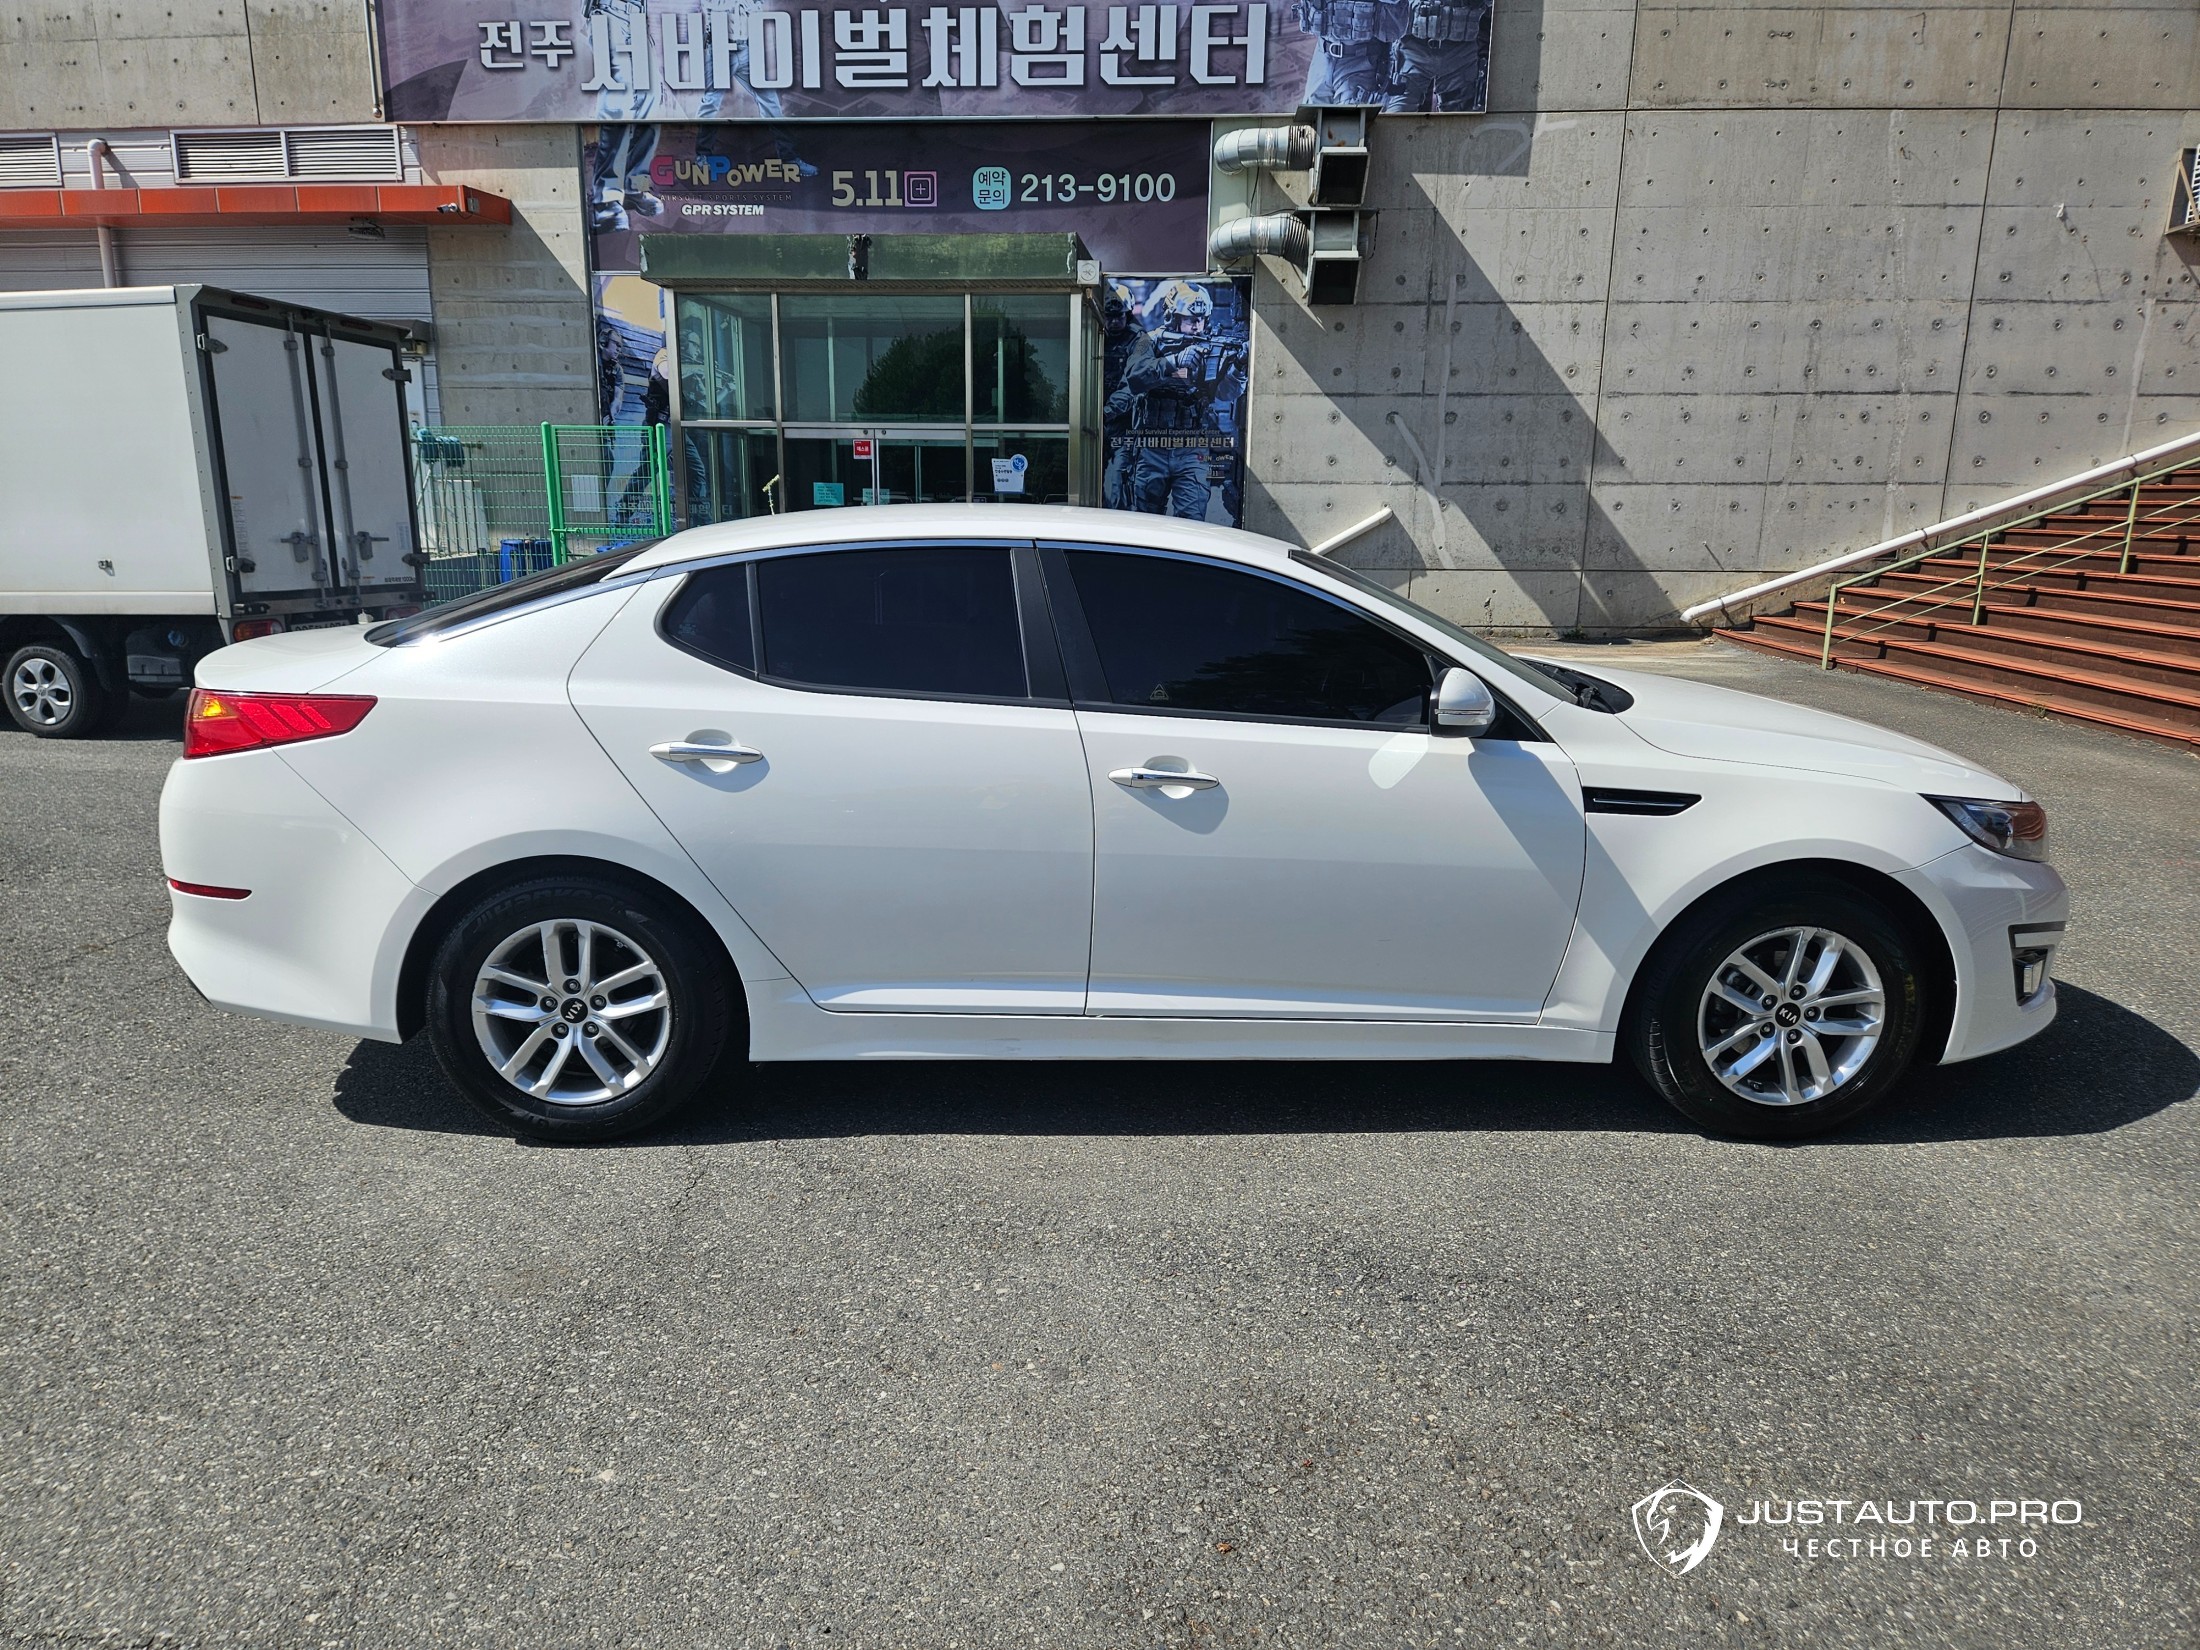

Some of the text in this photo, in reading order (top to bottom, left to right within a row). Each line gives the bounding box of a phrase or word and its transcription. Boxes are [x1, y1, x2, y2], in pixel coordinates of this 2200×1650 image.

[478, 3, 1268, 92] 전주 서바이벌체험센터
[978, 170, 1006, 187] 예약
[832, 169, 902, 208] 5.11
[977, 188, 1005, 205] 문의
[1020, 172, 1177, 204] 213-9100
[681, 204, 765, 216] GPR SYSTEM
[1168, 428, 1200, 436] Experience
[564, 1001, 584, 1021] KIA
[1778, 1006, 1798, 1024] KIA
